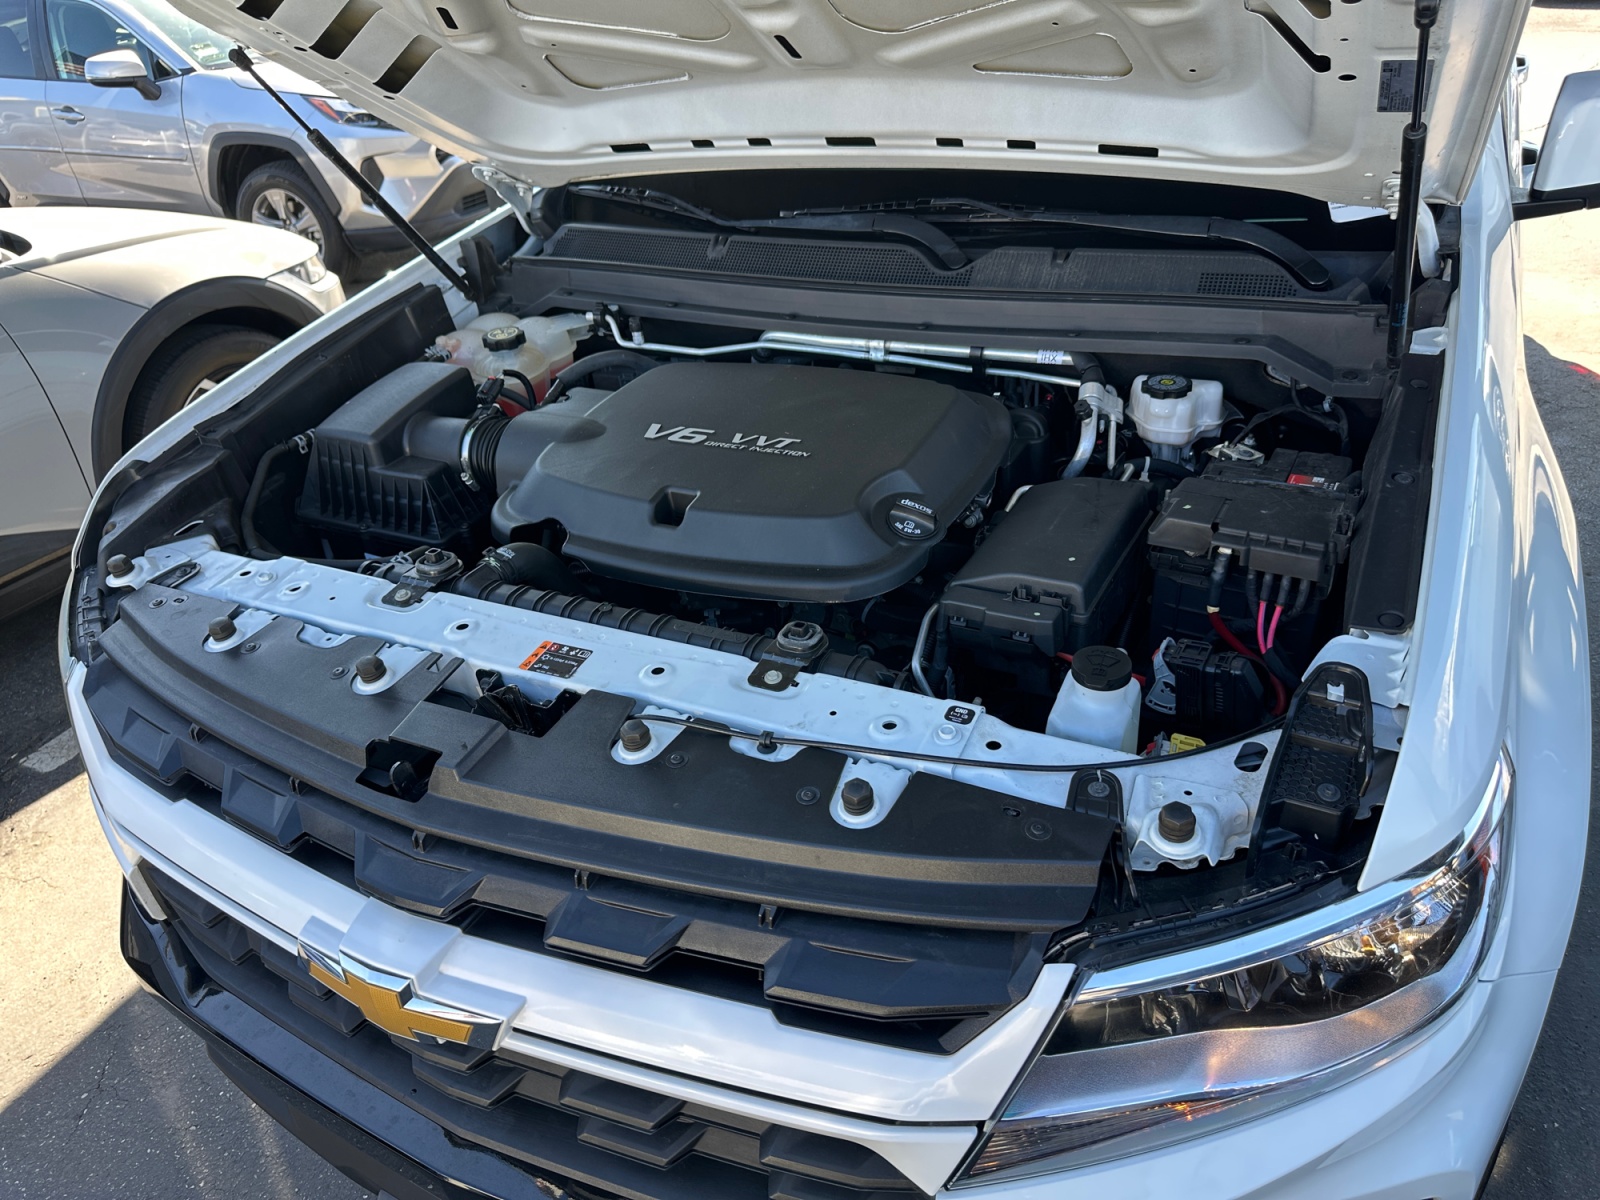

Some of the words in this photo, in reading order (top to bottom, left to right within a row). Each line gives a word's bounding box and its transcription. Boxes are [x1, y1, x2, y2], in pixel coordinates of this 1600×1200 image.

[644, 423, 716, 444] V6
[732, 432, 802, 448] VVT
[704, 440, 748, 450] DIRECT
[749, 446, 811, 457] INJECTION
[900, 498, 932, 514] dexos
